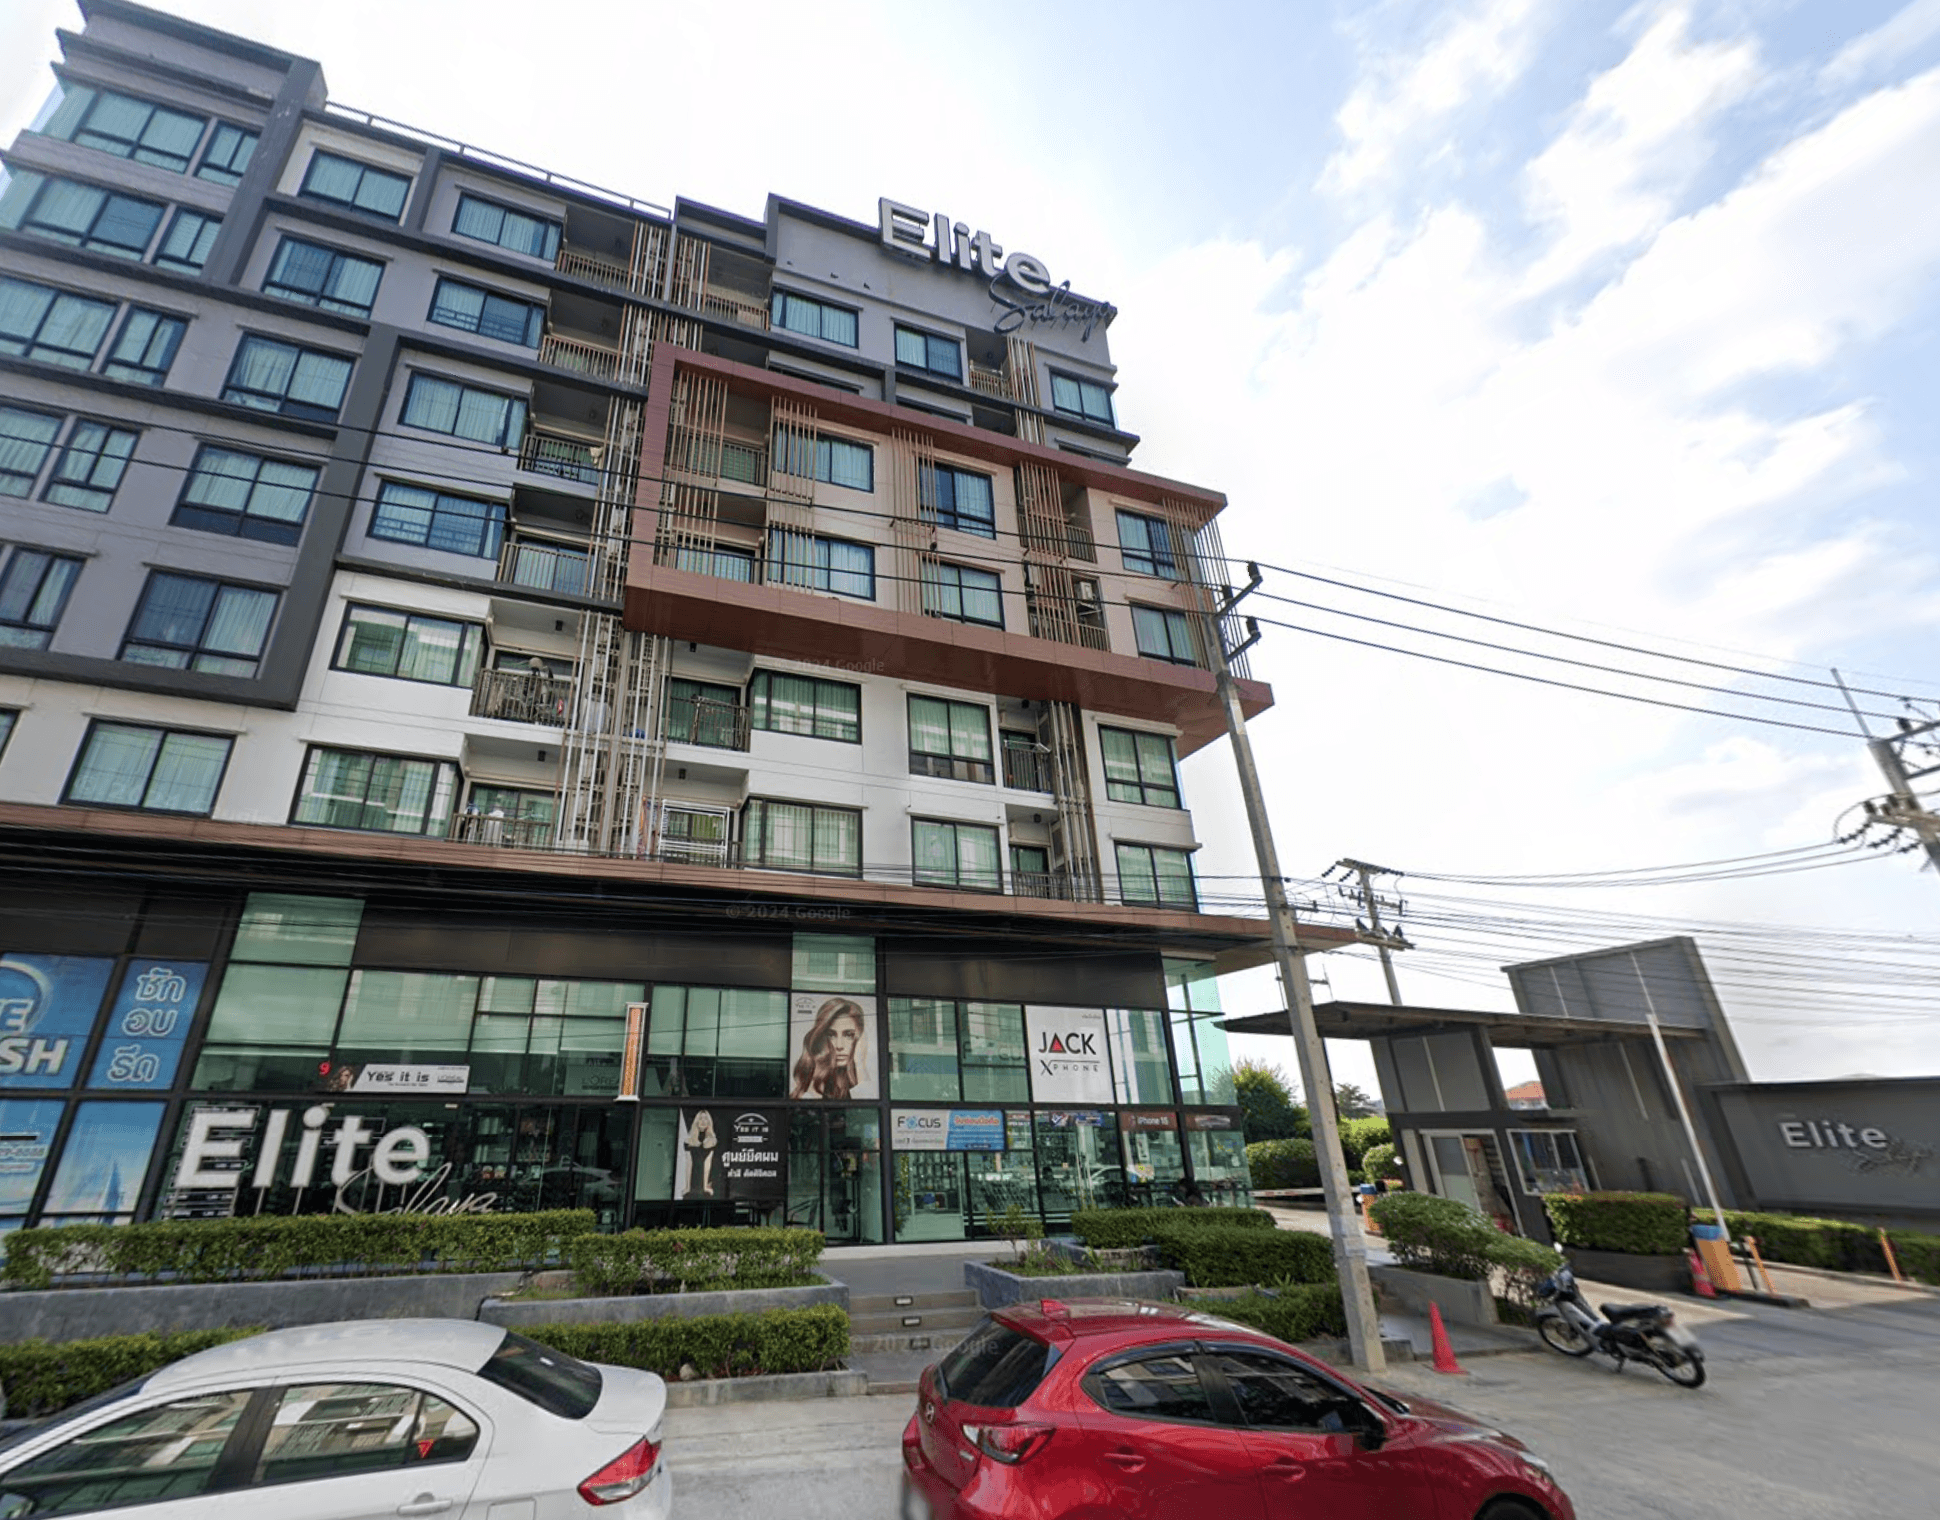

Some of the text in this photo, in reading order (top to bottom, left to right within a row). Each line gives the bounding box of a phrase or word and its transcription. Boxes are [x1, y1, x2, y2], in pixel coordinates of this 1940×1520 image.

[878, 196, 1051, 295] Elite
[1038, 1031, 1097, 1055] JACK
[367, 1071, 395, 1082] Yes
[399, 1071, 411, 1082] it
[416, 1071, 430, 1082] is
[174, 1104, 430, 1188] Elite
[1779, 1119, 1888, 1149] Elite
